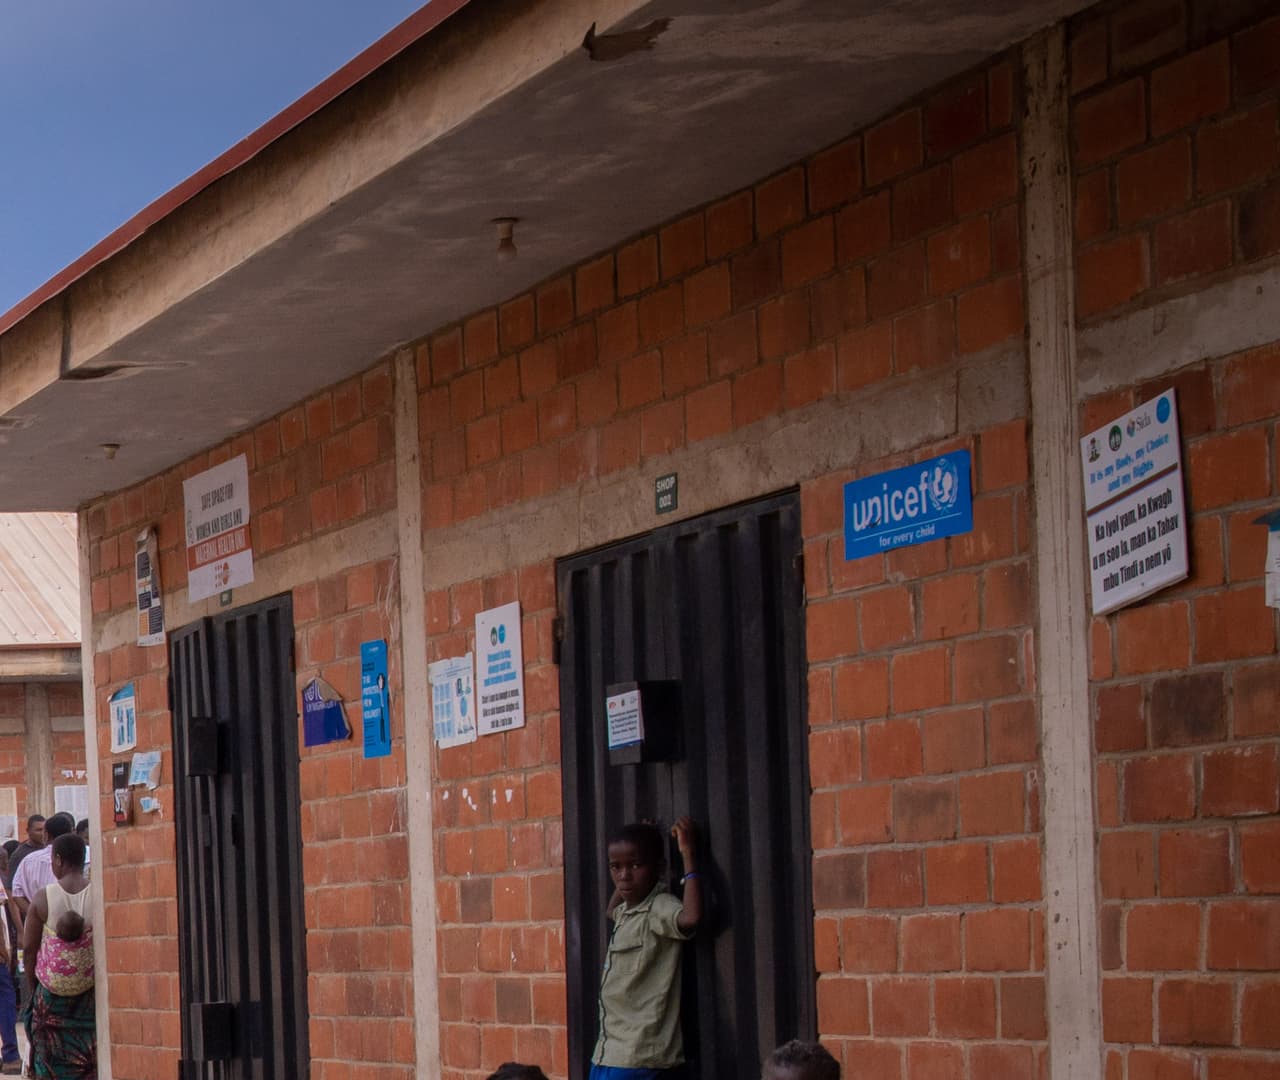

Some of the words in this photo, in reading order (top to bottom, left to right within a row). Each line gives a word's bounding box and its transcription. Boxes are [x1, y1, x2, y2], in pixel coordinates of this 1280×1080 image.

[853, 471, 928, 532] unicef
[1095, 524, 1105, 542] Ka
[1137, 503, 1147, 521] ka
[1147, 487, 1173, 515] Kwagh
[879, 535, 891, 547] for
[893, 531, 913, 545] every
[915, 523, 935, 539] child
